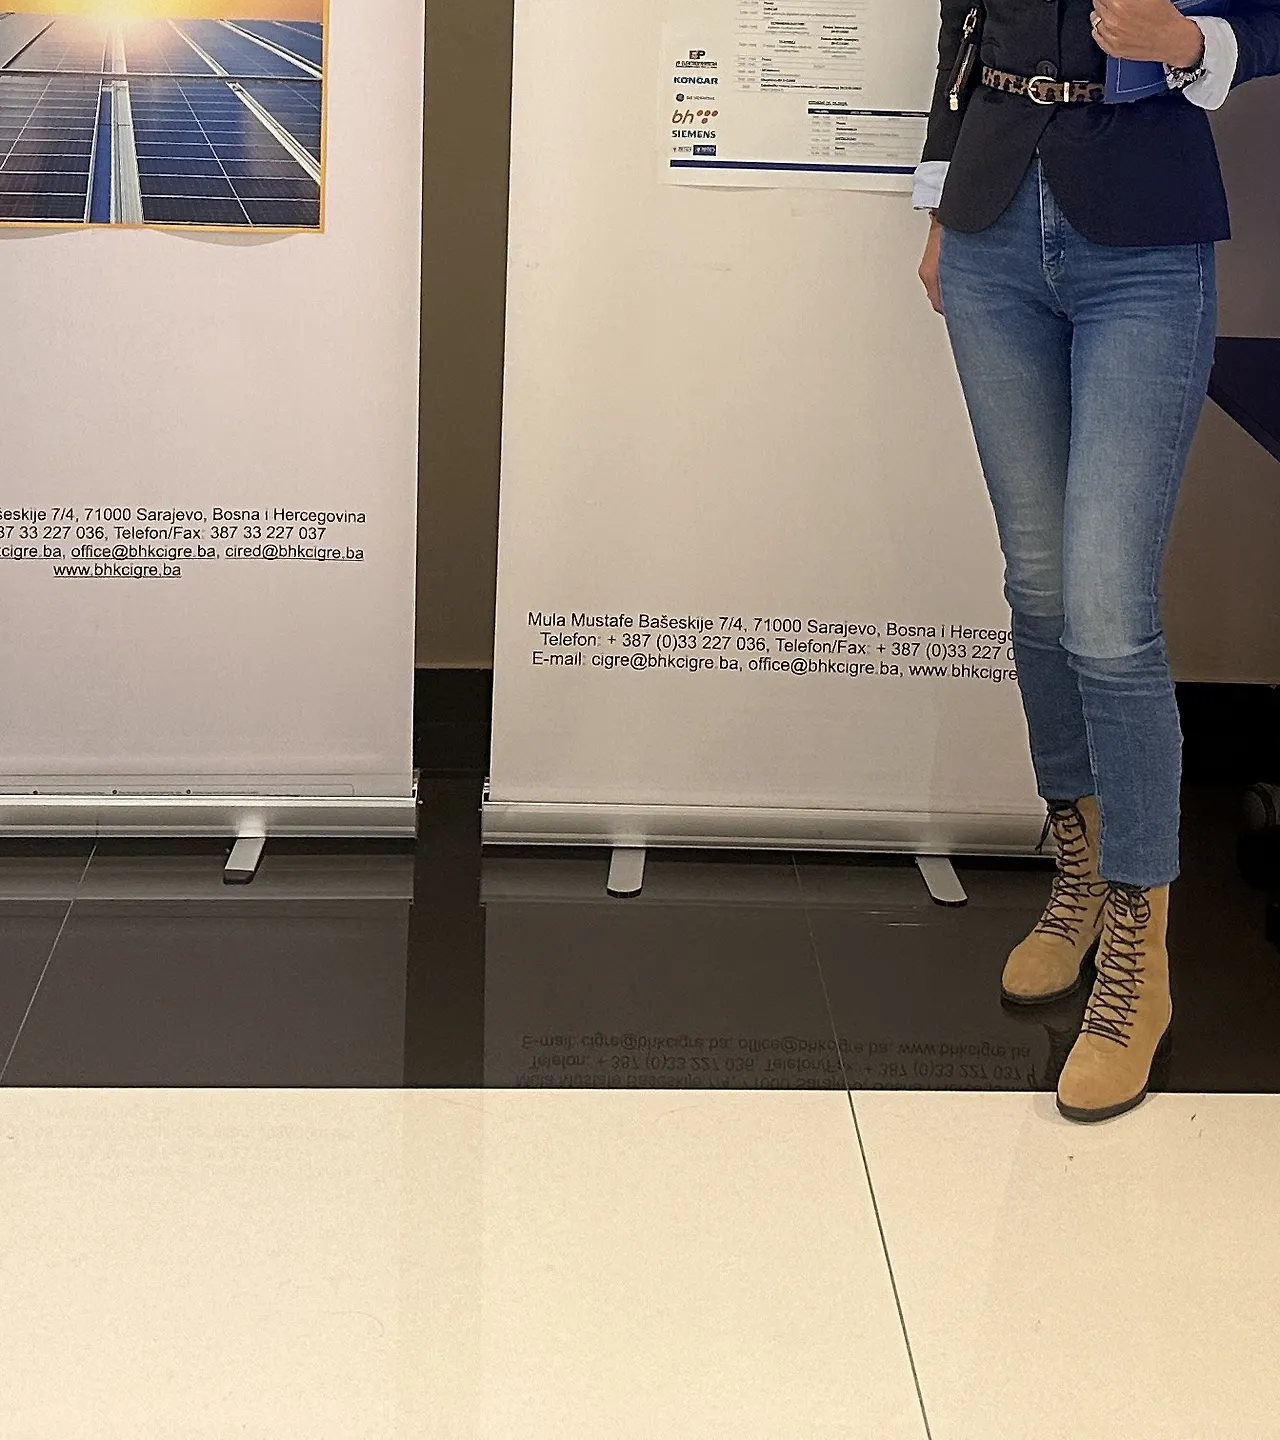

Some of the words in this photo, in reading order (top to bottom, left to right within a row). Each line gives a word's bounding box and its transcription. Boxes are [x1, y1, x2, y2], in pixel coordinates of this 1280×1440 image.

[671, 130, 716, 138] SIEMENS
[52, 508, 79, 523] 7/4,
[85, 508, 132, 521] 71000
[136, 508, 207, 524] Sarajevo,
[213, 508, 260, 522] Bosna
[273, 508, 366, 525] Hercegovina
[20, 526, 38, 539] 33
[42, 526, 71, 539] 227
[76, 526, 108, 541] 036,
[114, 526, 205, 540] Telefon/Fax:
[210, 526, 237, 539] 387
[243, 526, 262, 539] 33
[266, 526, 294, 540] 227
[298, 527, 326, 540] 037
[71, 544, 220, 561] office@bhkcigre.ba,
[225, 545, 364, 562] cired@bhkcigre.ba
[53, 563, 182, 579] www.bhkcigre.ba
[528, 612, 566, 627] Mula
[571, 612, 633, 628] Mustafe
[639, 614, 714, 633] Bašeskije
[719, 617, 748, 633] 7/4,
[754, 618, 802, 634] 71000
[807, 620, 881, 638] Sarajevo,
[887, 623, 936, 638] Bosna
[540, 632, 601, 647] Telefon:
[622, 633, 651, 648] 387
[656, 634, 697, 651] (0)33
[702, 636, 731, 650] 227
[736, 636, 770, 653] 036,
[776, 638, 869, 655] Telefon/Fax:
[891, 642, 920, 657] 387
[925, 643, 967, 661] (0)33
[972, 645, 1001, 660] 227
[532, 652, 585, 666] E-mail:
[591, 653, 743, 672] cigre@bhkcigre.ba,
[748, 657, 903, 678] office@bhkcigre.ba,
